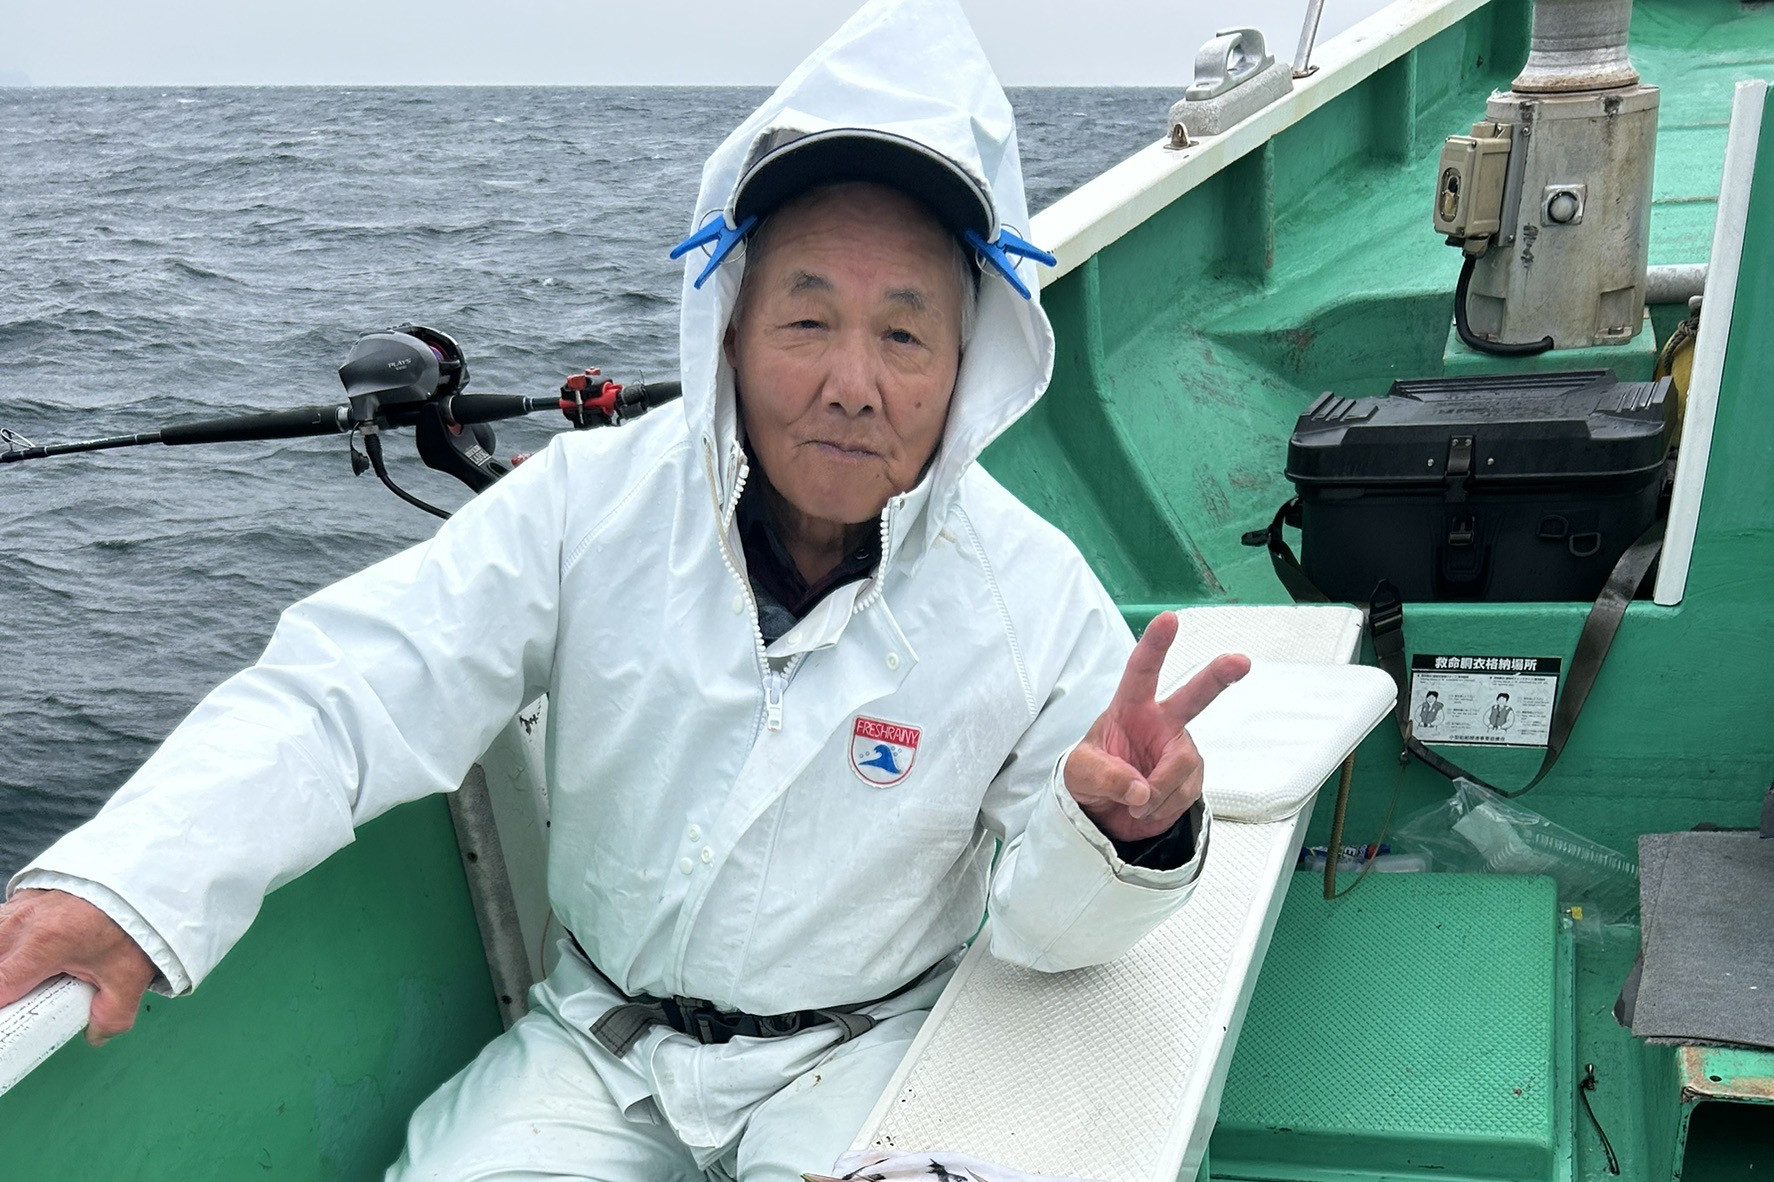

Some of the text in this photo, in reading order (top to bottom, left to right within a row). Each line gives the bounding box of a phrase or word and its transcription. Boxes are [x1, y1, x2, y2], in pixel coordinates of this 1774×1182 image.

[1434, 656, 1538, 672] 救命胴衣格納場所
[856, 720, 919, 745] FRESHRAINY
